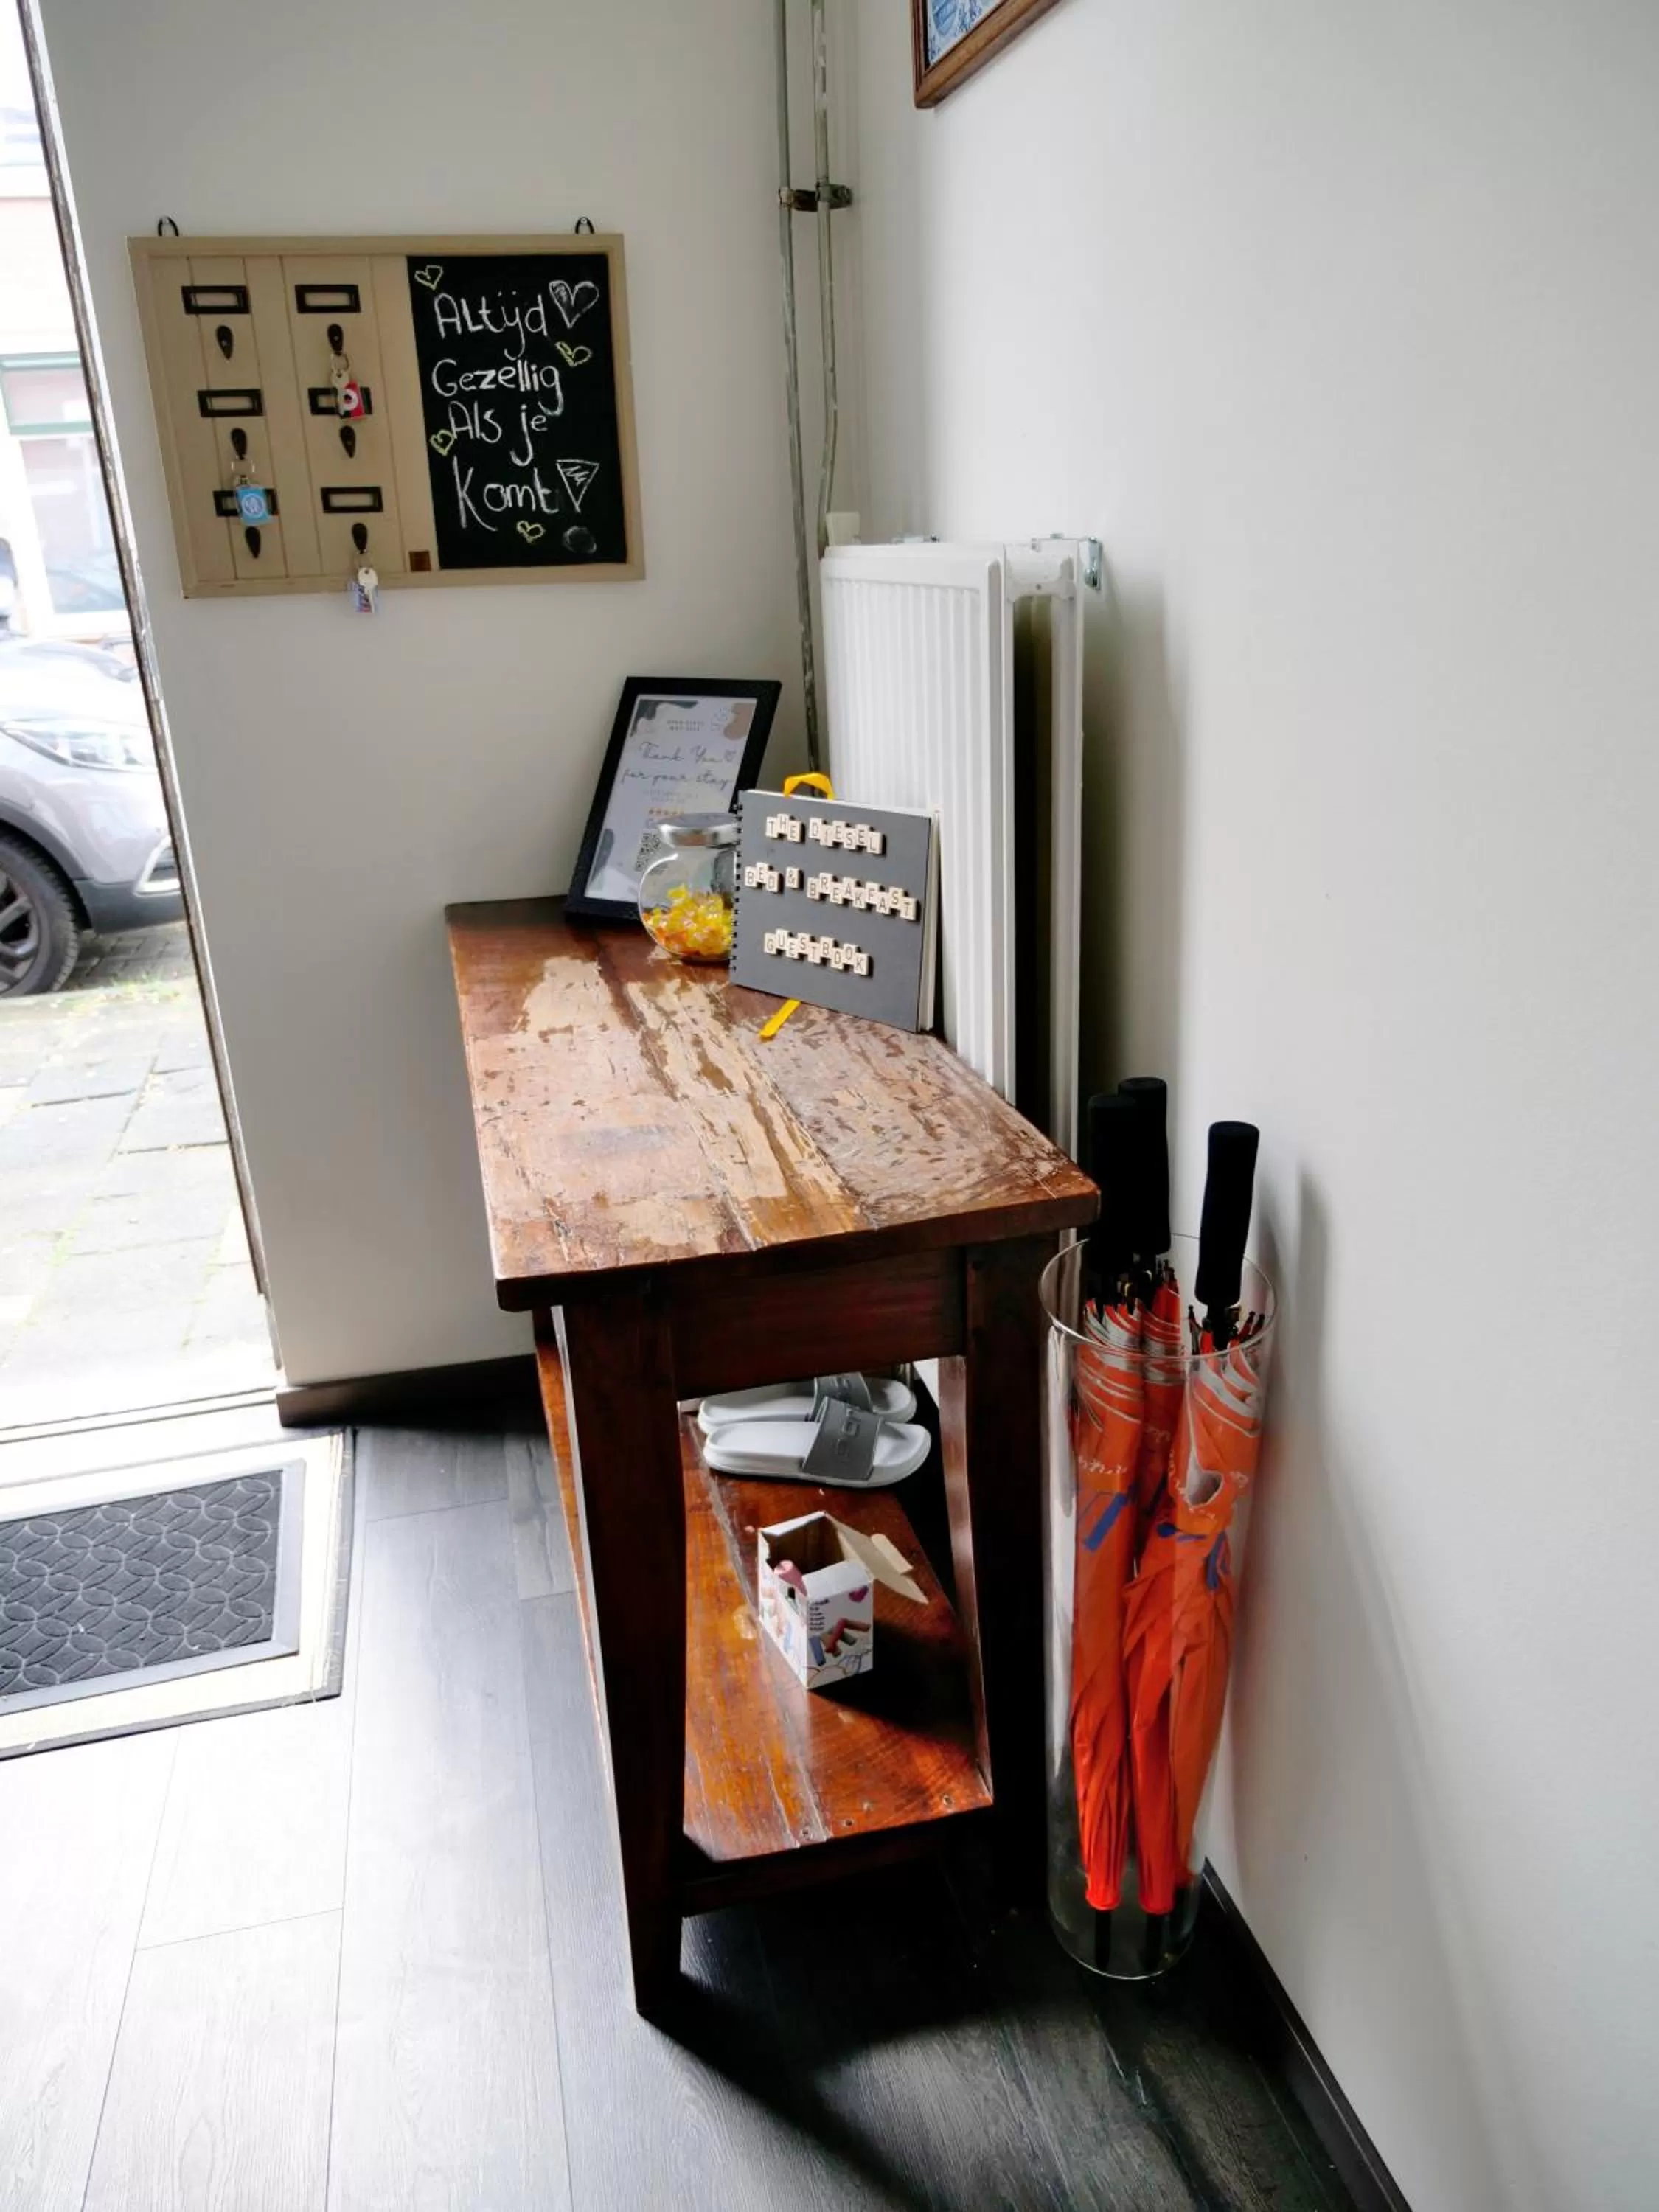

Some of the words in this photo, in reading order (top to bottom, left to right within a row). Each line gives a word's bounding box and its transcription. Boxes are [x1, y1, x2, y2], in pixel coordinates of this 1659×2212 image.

[431, 358, 564, 416] Gezellig
[448, 400, 502, 443] Als
[509, 403, 549, 466] je
[453, 455, 560, 532] Komt
[766, 815, 800, 841] THE
[810, 818, 880, 853] DIESEL
[745, 863, 777, 891] BED
[787, 869, 799, 887] &
[808, 874, 914, 919] BREAKFAST
[765, 931, 867, 973] GUESTBOOK
